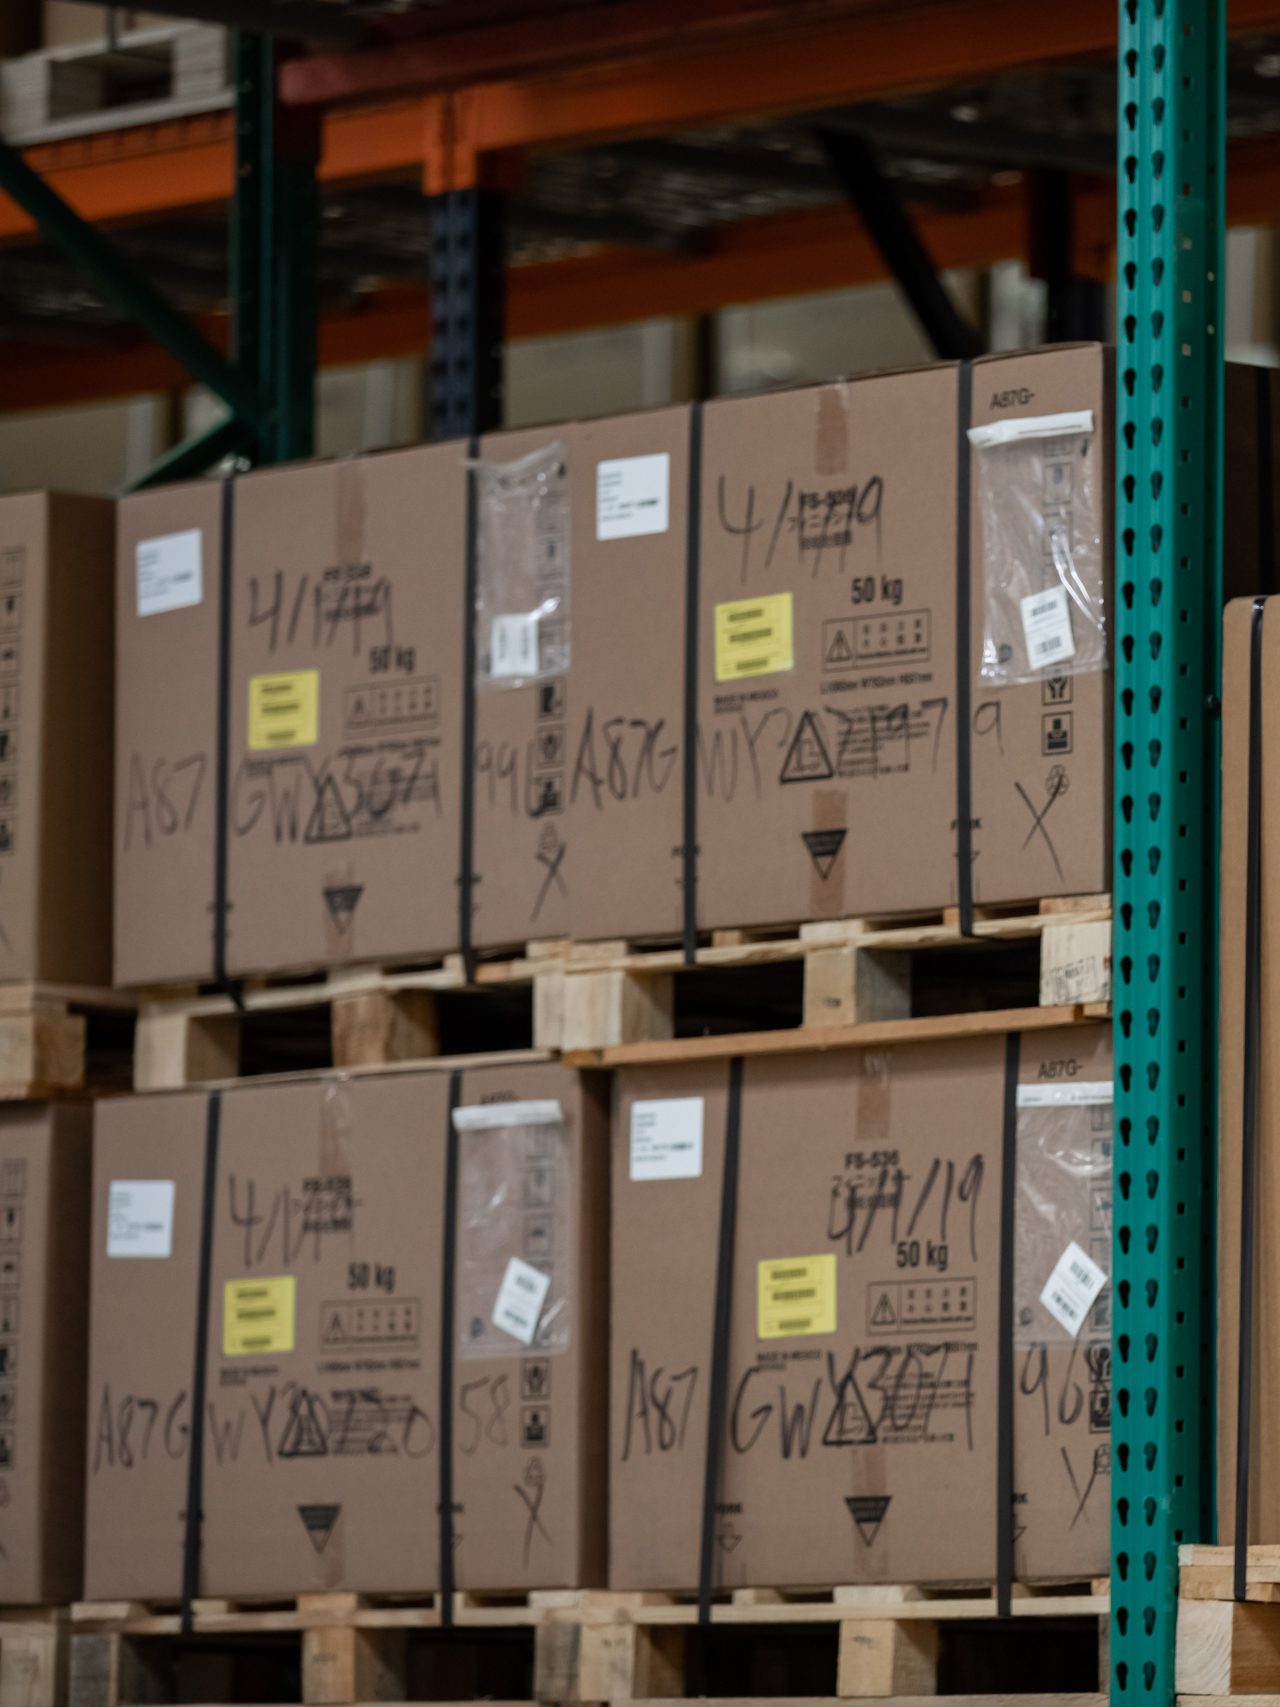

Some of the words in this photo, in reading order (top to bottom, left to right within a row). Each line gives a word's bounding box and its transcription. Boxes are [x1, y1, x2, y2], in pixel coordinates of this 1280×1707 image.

[851, 576, 876, 604] 50
[881, 573, 904, 606] kg
[368, 646, 391, 674] 50
[897, 1240, 921, 1269] 50
[926, 1240, 949, 1273] kg
[347, 1262, 370, 1291] 50
[374, 1261, 396, 1295] kg
[621, 1347, 700, 1462] A87
